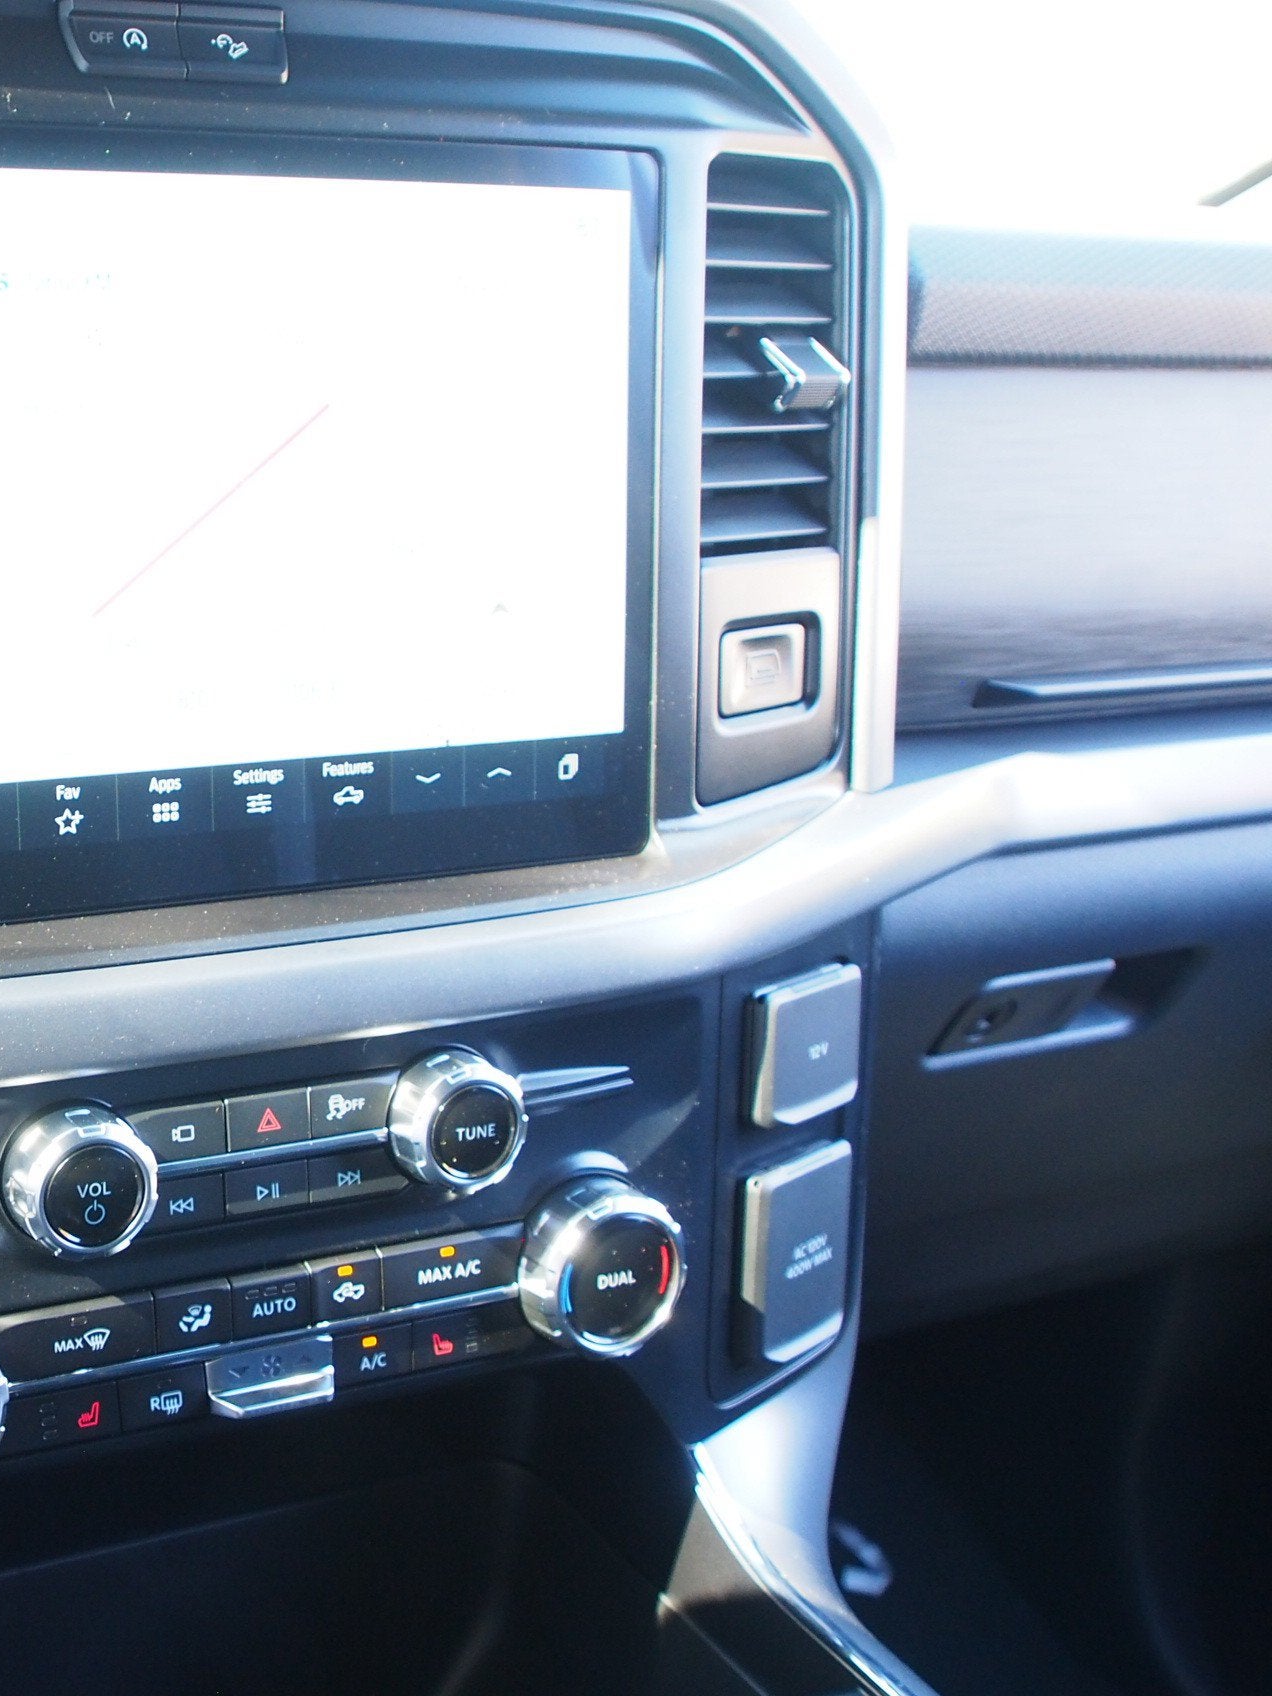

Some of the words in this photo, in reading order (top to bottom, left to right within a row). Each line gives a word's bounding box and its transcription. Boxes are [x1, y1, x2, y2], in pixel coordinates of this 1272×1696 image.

[88, 31, 114, 44] OFF
[233, 766, 284, 787] Settings
[322, 760, 375, 778] Features
[55, 784, 81, 801] Fav
[148, 776, 182, 795] Apps
[343, 1097, 365, 1112] OFF
[456, 1122, 496, 1142] TUNE
[77, 1181, 111, 1199] VOL
[418, 1263, 452, 1285] MAX
[453, 1258, 481, 1279] A/C
[596, 1269, 636, 1291] DUAL
[252, 1297, 297, 1319] AUTO
[54, 1335, 84, 1354] MAX
[360, 1352, 387, 1372] A/C
[150, 1396, 162, 1412] R
